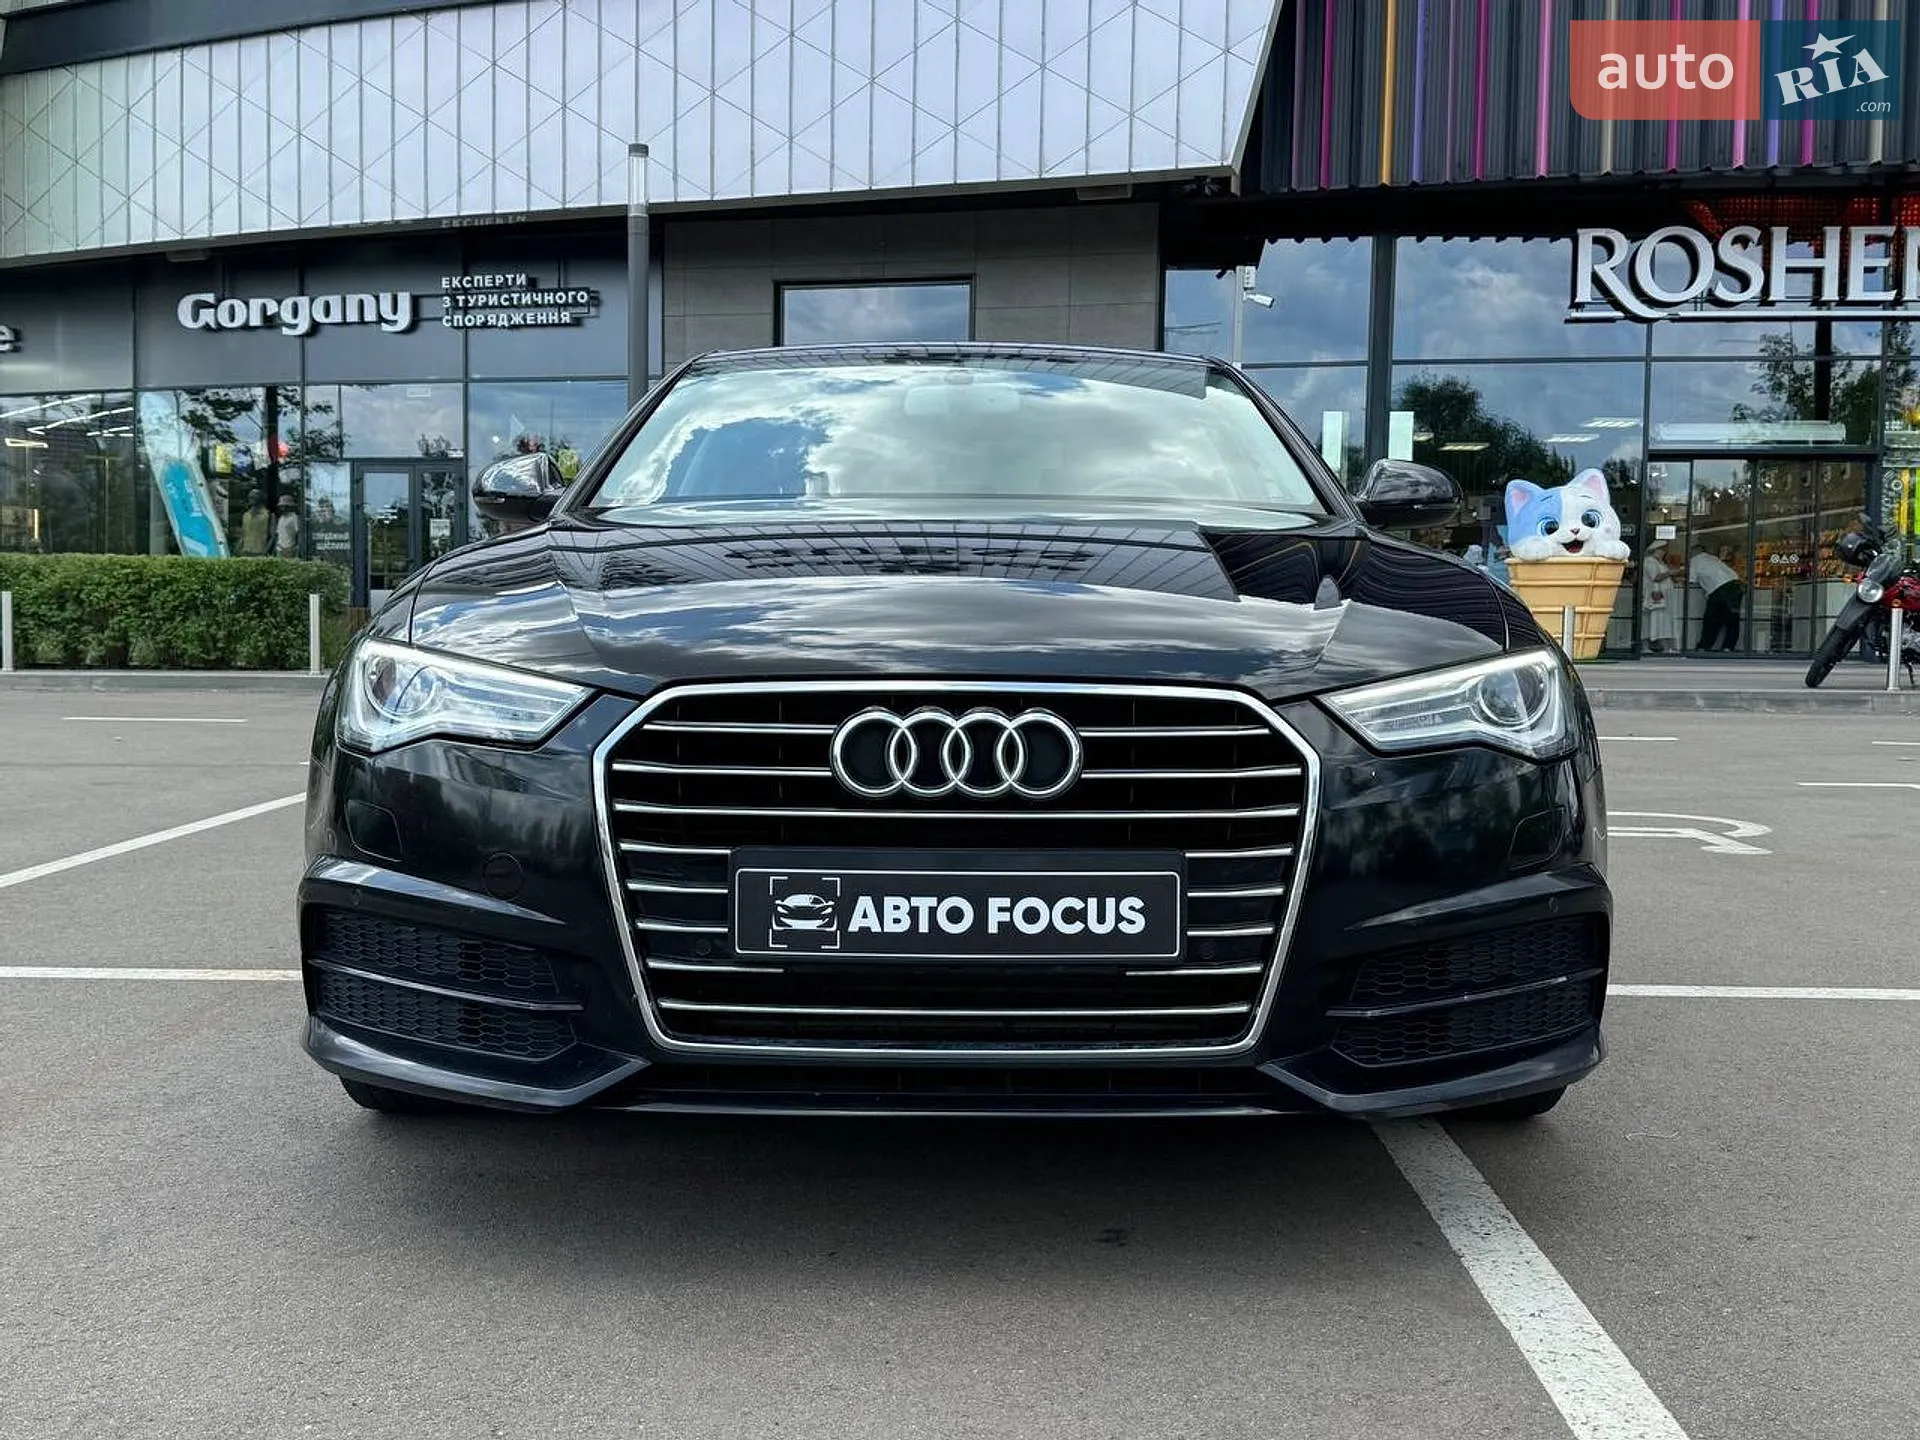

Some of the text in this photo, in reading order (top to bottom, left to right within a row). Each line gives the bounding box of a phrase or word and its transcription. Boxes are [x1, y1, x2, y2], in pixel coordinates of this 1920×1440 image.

[441, 273, 527, 289] ЕКСПЕРТИ
[456, 291, 588, 308] ТУРИСТИЧНОГО
[177, 291, 412, 336] Gorgany
[442, 311, 571, 328] СПОРЯДЖЕННЯ
[848, 896, 1147, 934] АВТО FOCUS
